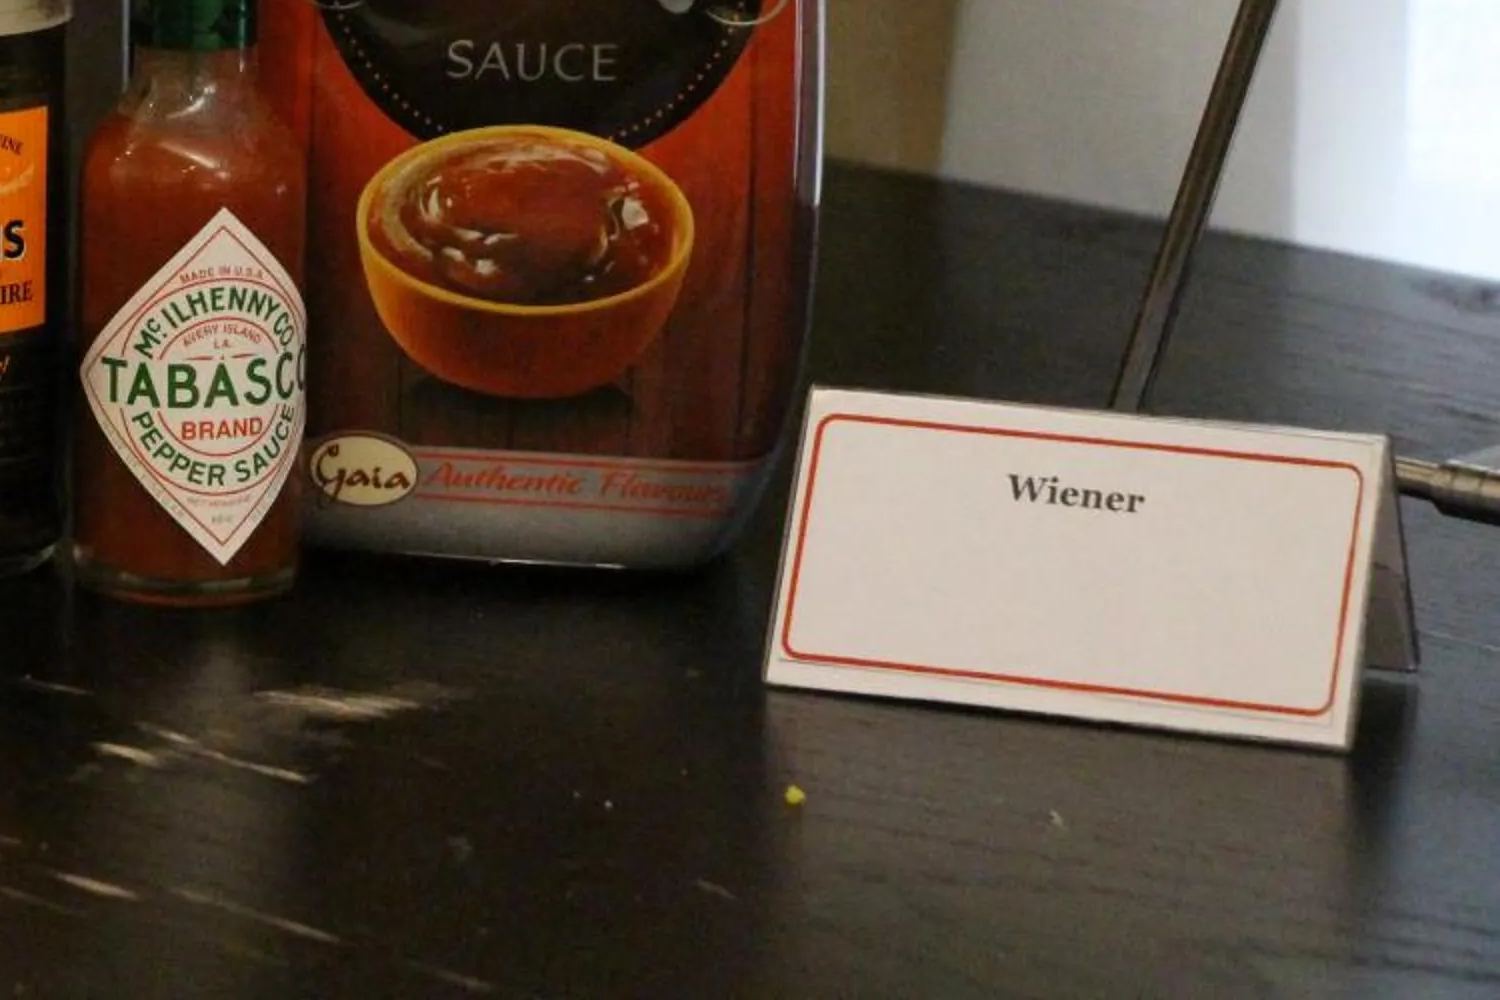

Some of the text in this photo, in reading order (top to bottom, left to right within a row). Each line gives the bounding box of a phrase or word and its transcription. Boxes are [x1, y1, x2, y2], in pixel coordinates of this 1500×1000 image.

[446, 39, 620, 82] SAUCE
[132, 409, 225, 487] PEPPER
[234, 404, 296, 484] SAUCE
[181, 416, 264, 442] BRAND
[425, 461, 585, 495] Authentic
[1008, 473, 1146, 512] Wiener
